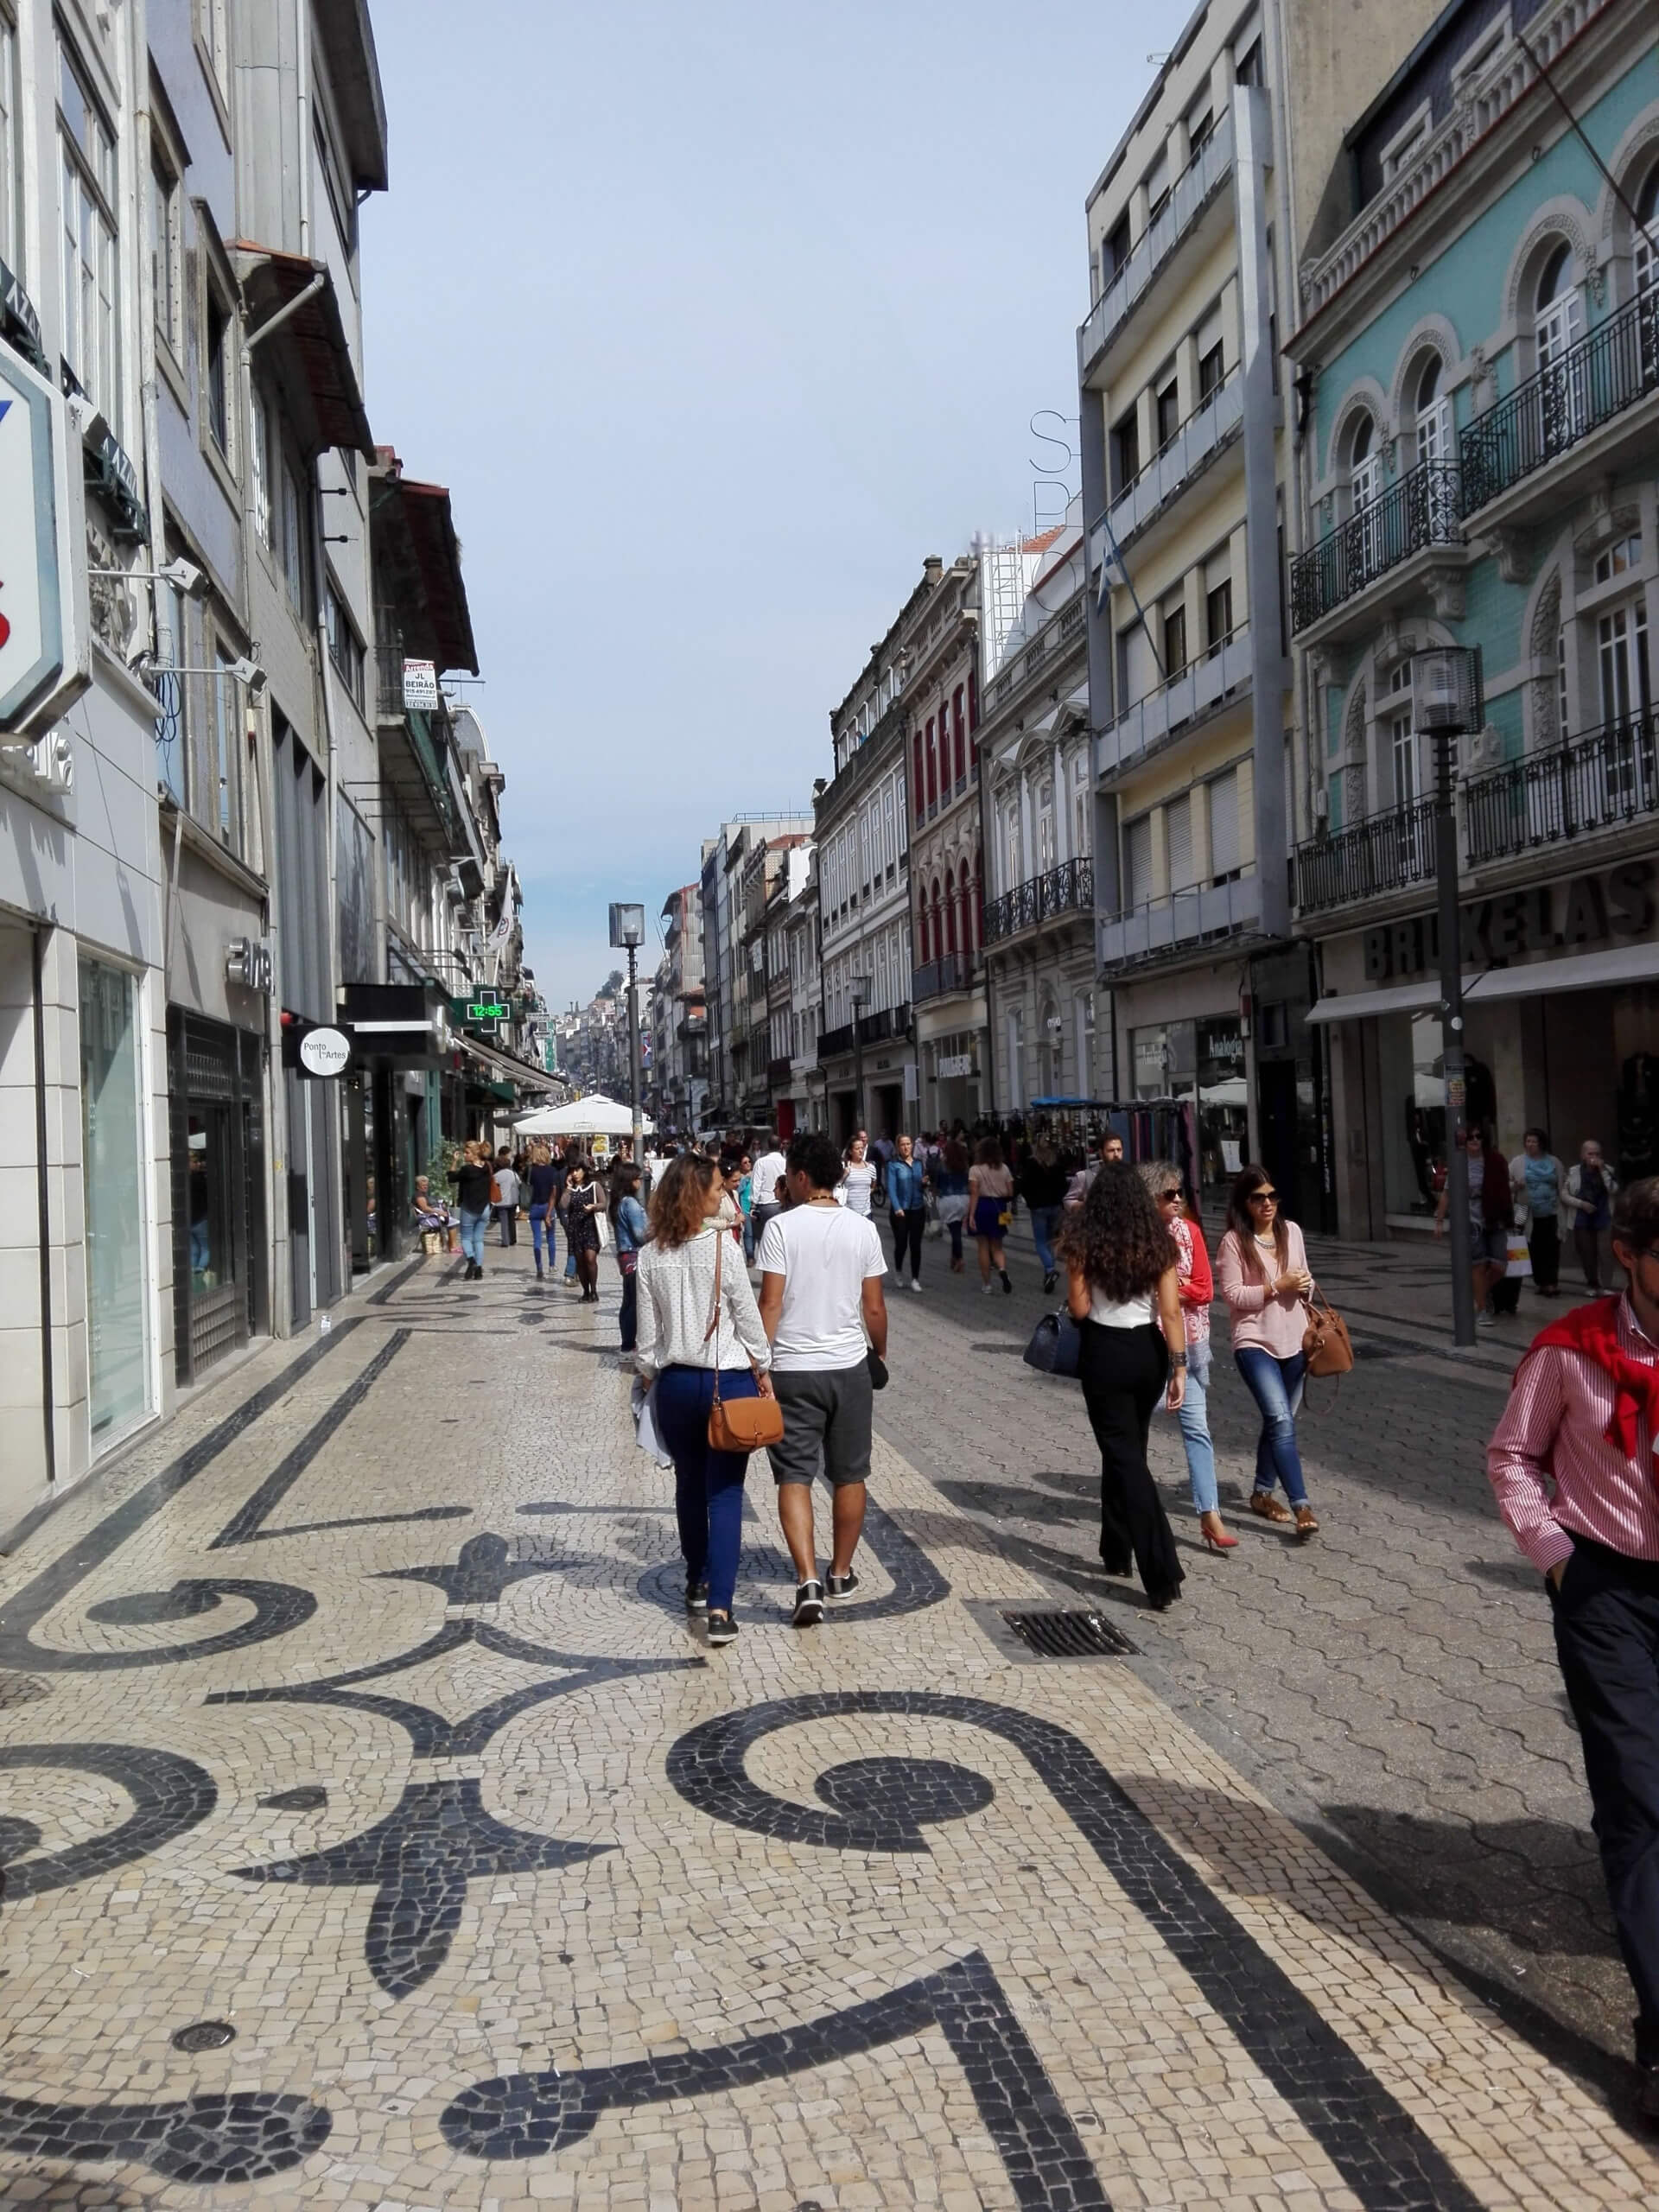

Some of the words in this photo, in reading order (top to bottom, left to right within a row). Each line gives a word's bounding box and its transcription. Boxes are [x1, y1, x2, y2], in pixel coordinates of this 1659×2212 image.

[405, 680, 435, 689] BEIRÃO
[473, 1005, 503, 1017] 12:55
[304, 1042, 327, 1059] Ponto
[326, 1051, 346, 1059] Artes
